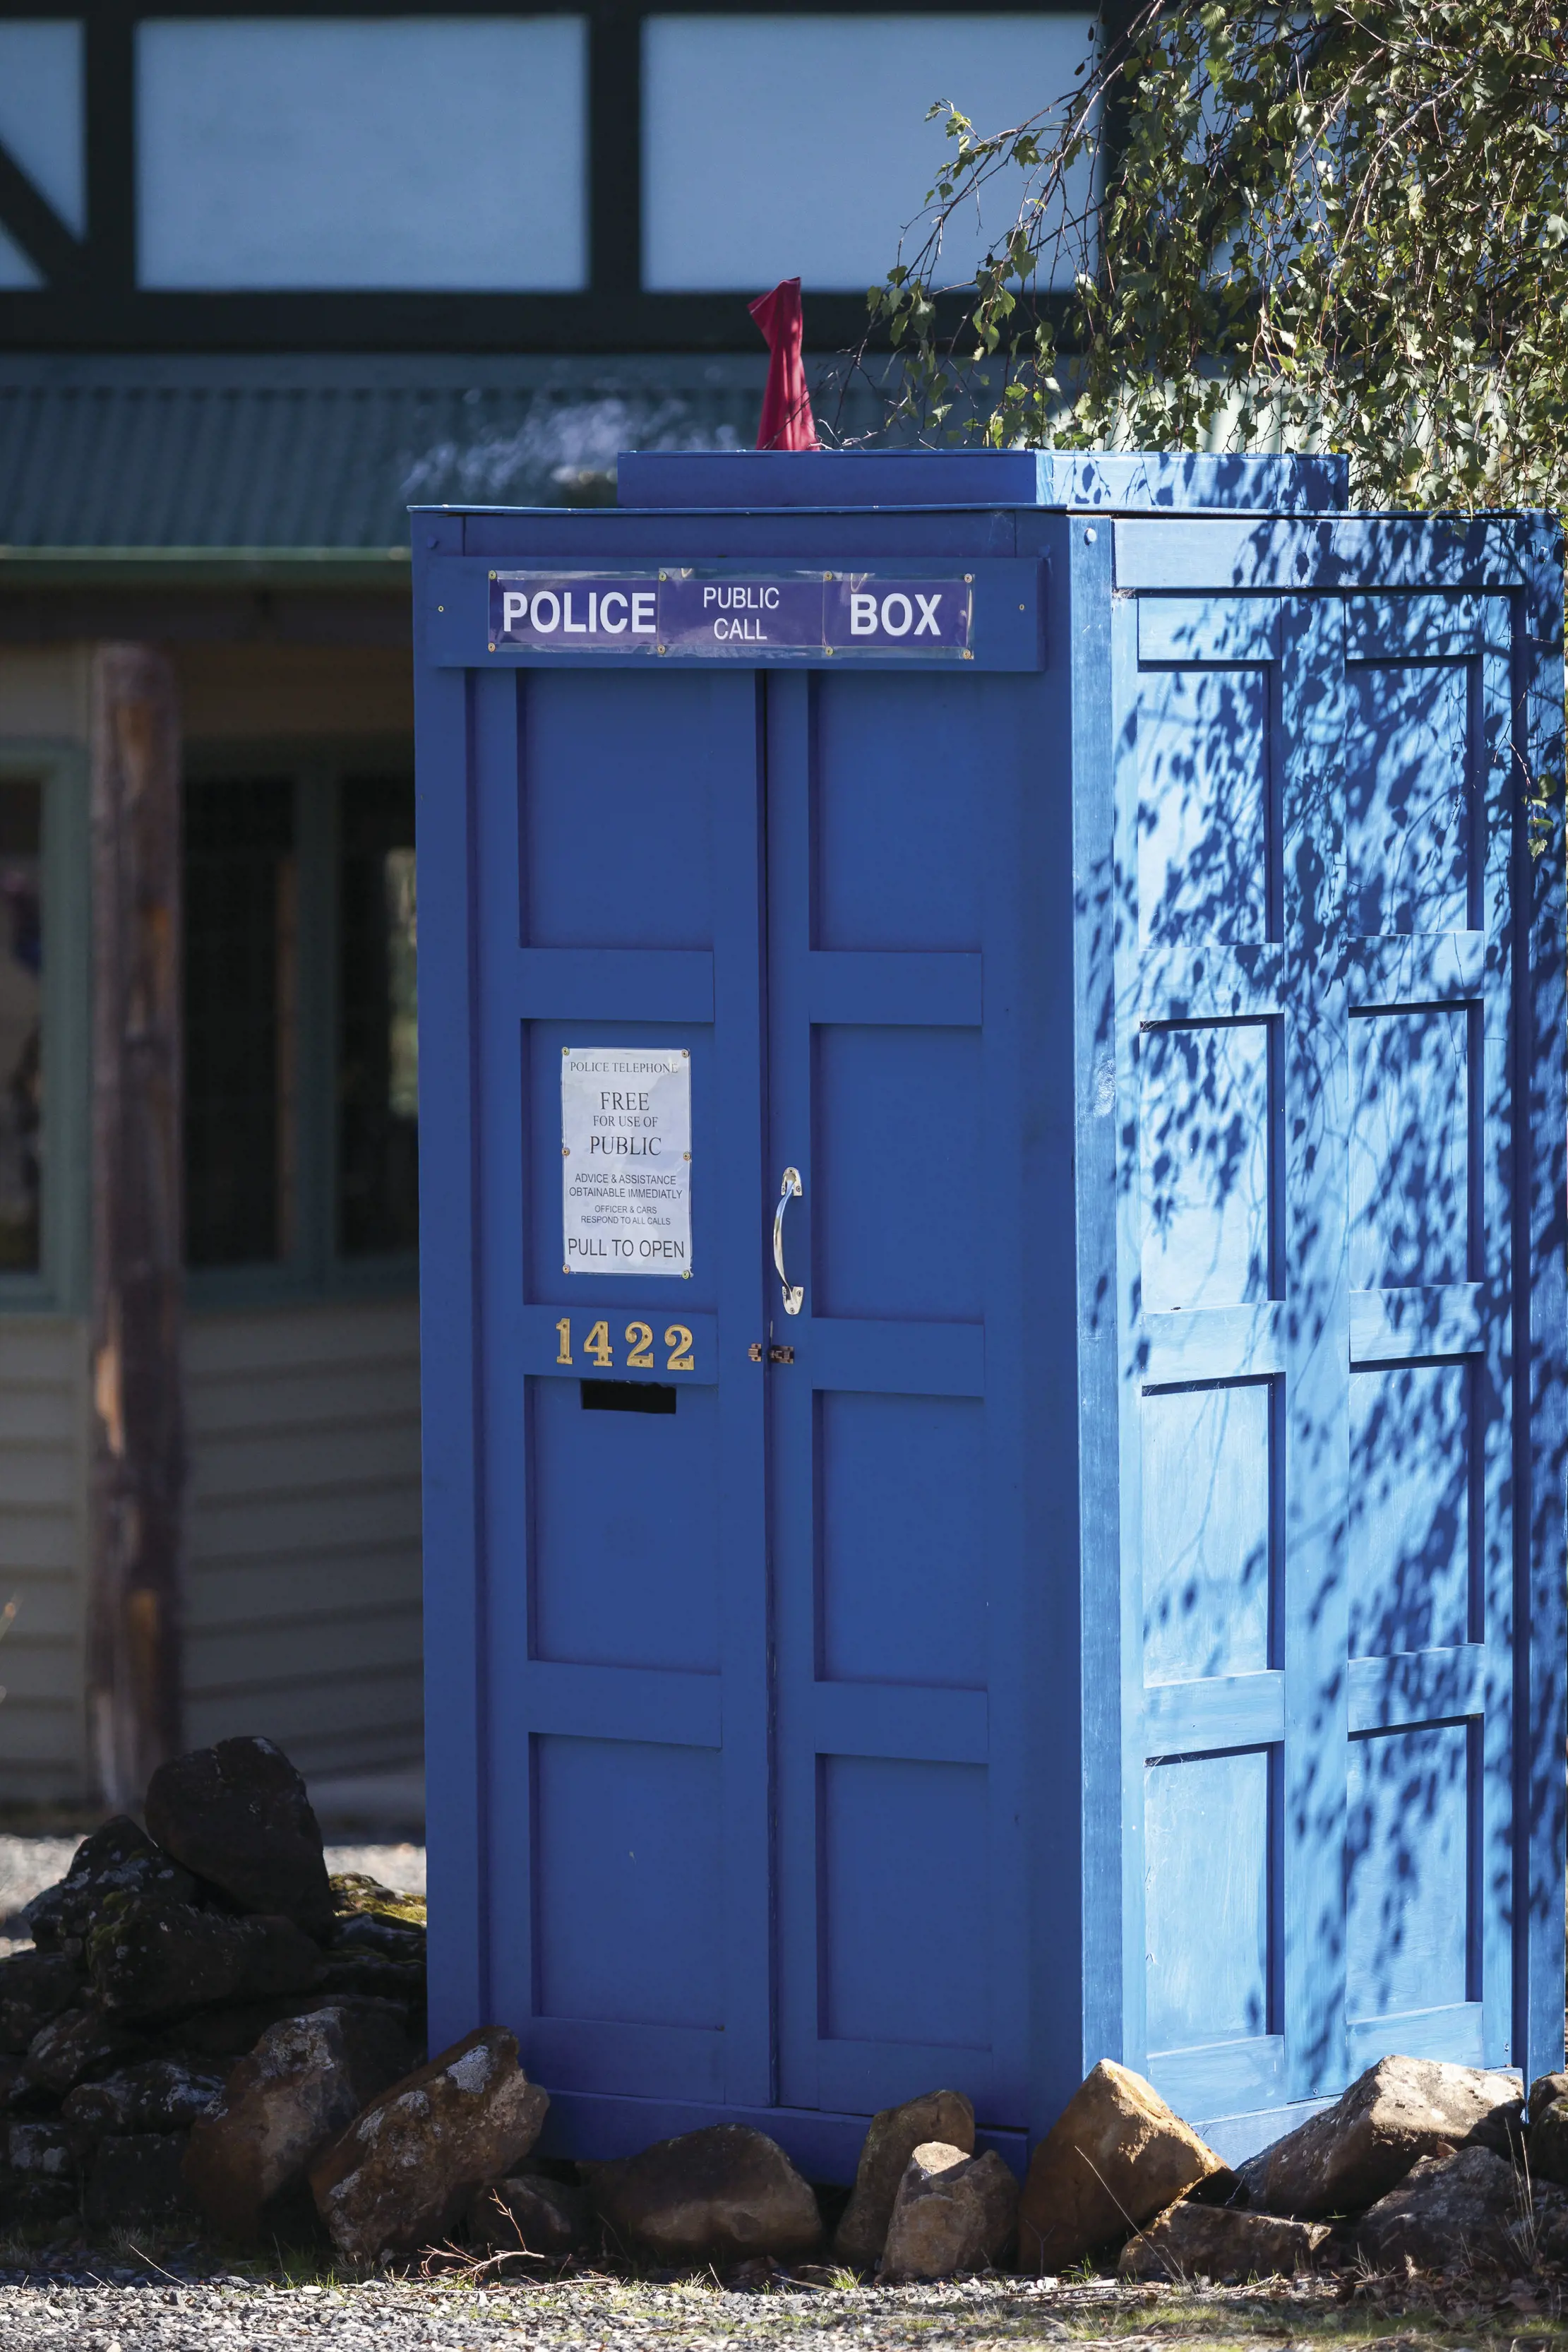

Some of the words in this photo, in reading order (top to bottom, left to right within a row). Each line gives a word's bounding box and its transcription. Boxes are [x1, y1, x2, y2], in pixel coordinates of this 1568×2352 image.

[703, 587, 780, 609] PUBLIC
[503, 592, 656, 633] POLICE
[850, 593, 942, 635] BOX
[713, 618, 767, 640] CALL
[570, 1061, 609, 1072] POLICE
[613, 1063, 678, 1073] TELEPHONE
[600, 1092, 650, 1111] FREE
[593, 1115, 616, 1127] FOR
[618, 1116, 640, 1127] USE
[643, 1116, 658, 1127] OF
[590, 1135, 662, 1156] PUBLIC
[575, 1173, 609, 1183] ADVICE
[611, 1174, 617, 1183] &
[619, 1174, 676, 1185] ASSISTANCE
[569, 1187, 625, 1198] OBTAINABLE
[628, 1188, 683, 1199] IMMEDIATLY
[594, 1205, 628, 1213] OFFICER
[581, 1215, 618, 1224] RESPOND
[568, 1238, 607, 1256] PULL
[611, 1239, 634, 1257] TO
[639, 1240, 684, 1258] OPEN
[556, 1318, 694, 1371] 1422
